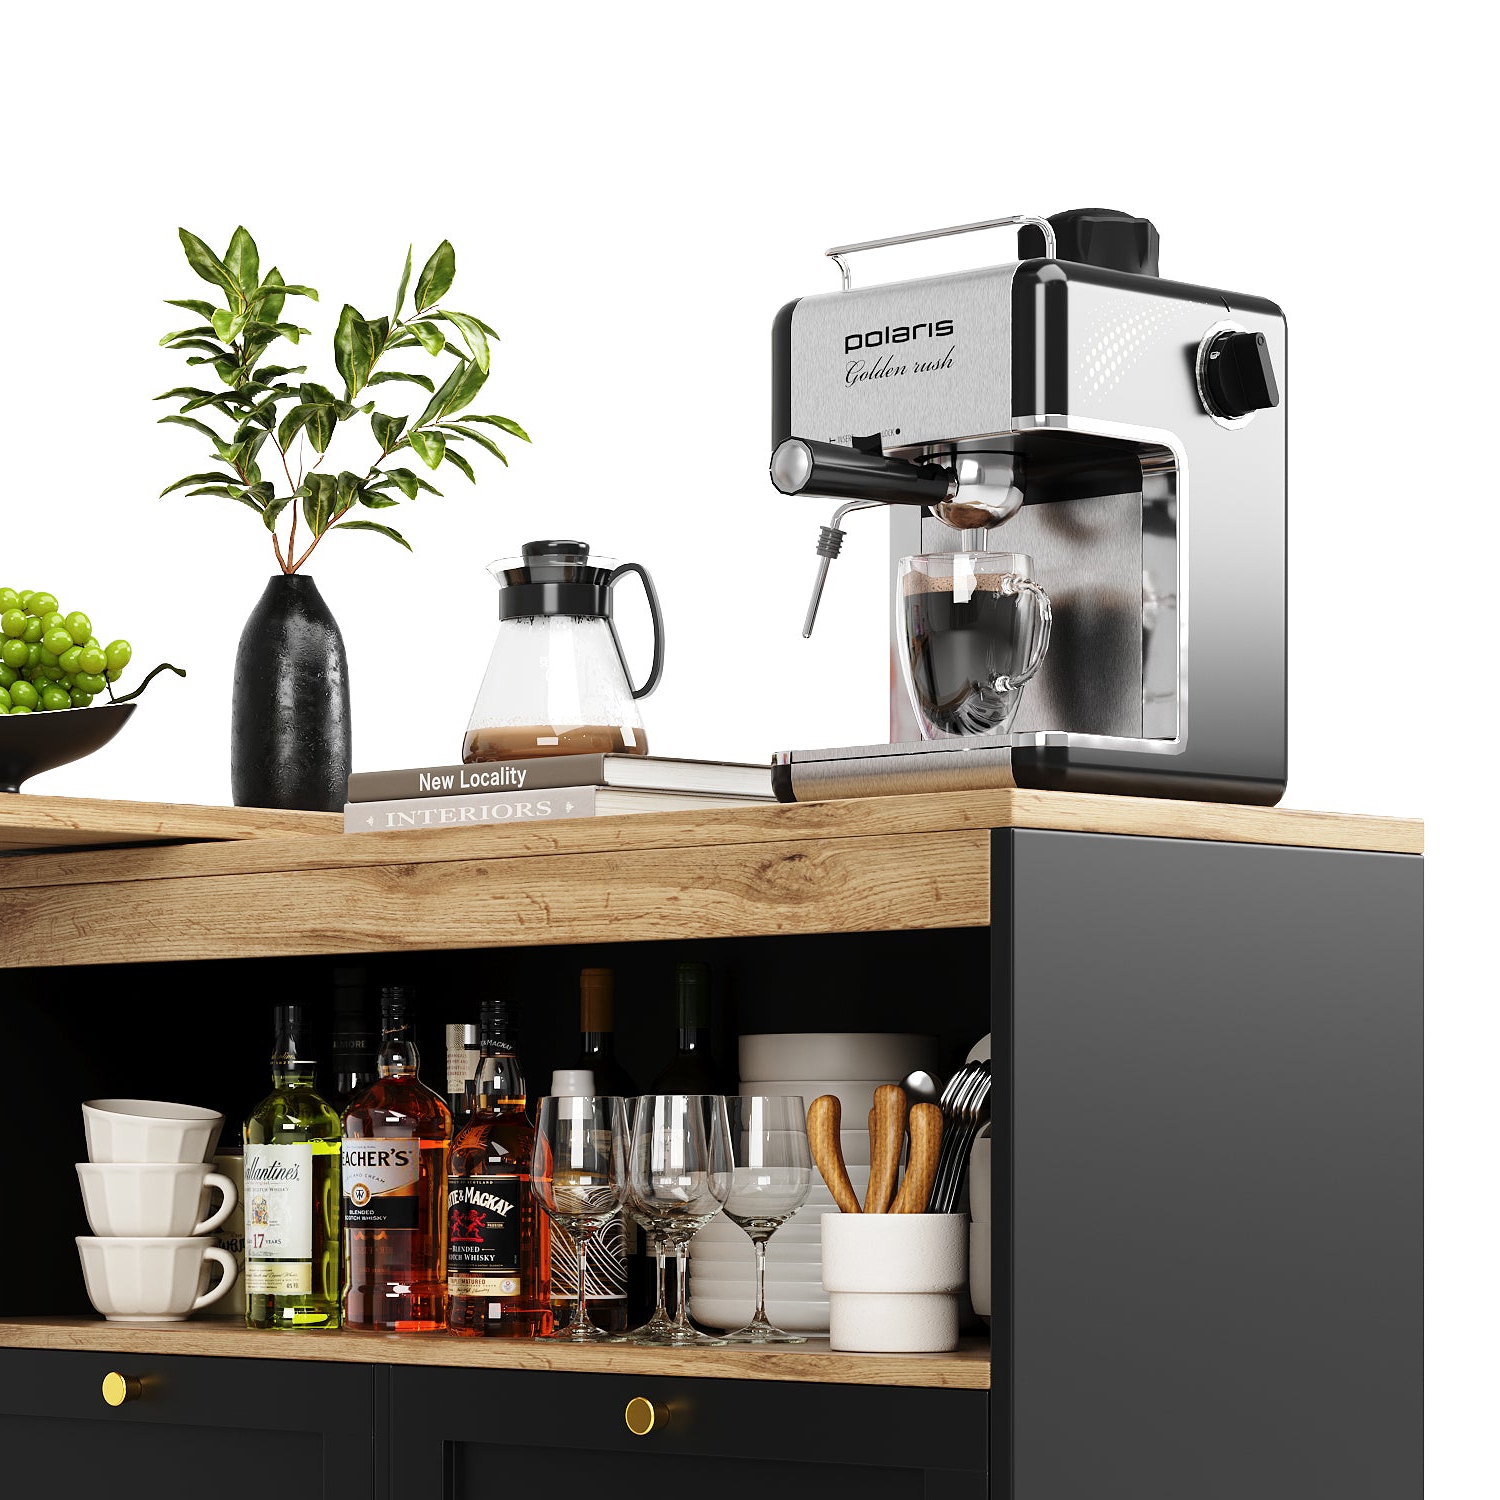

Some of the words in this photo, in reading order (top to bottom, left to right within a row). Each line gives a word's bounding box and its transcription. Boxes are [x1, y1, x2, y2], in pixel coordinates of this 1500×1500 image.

[844, 319, 954, 355] polaris
[844, 354, 907, 389] Golden
[913, 345, 956, 374] rush
[419, 772, 455, 792] New
[460, 766, 527, 789] Locality
[385, 800, 552, 828] INTERIORS
[487, 1039, 513, 1051] MACKAY
[464, 1186, 515, 1218] MACKAY
[253, 1233, 265, 1249] 17
[452, 1245, 480, 1253] BLENDED
[464, 1253, 496, 1262] WHISKY
